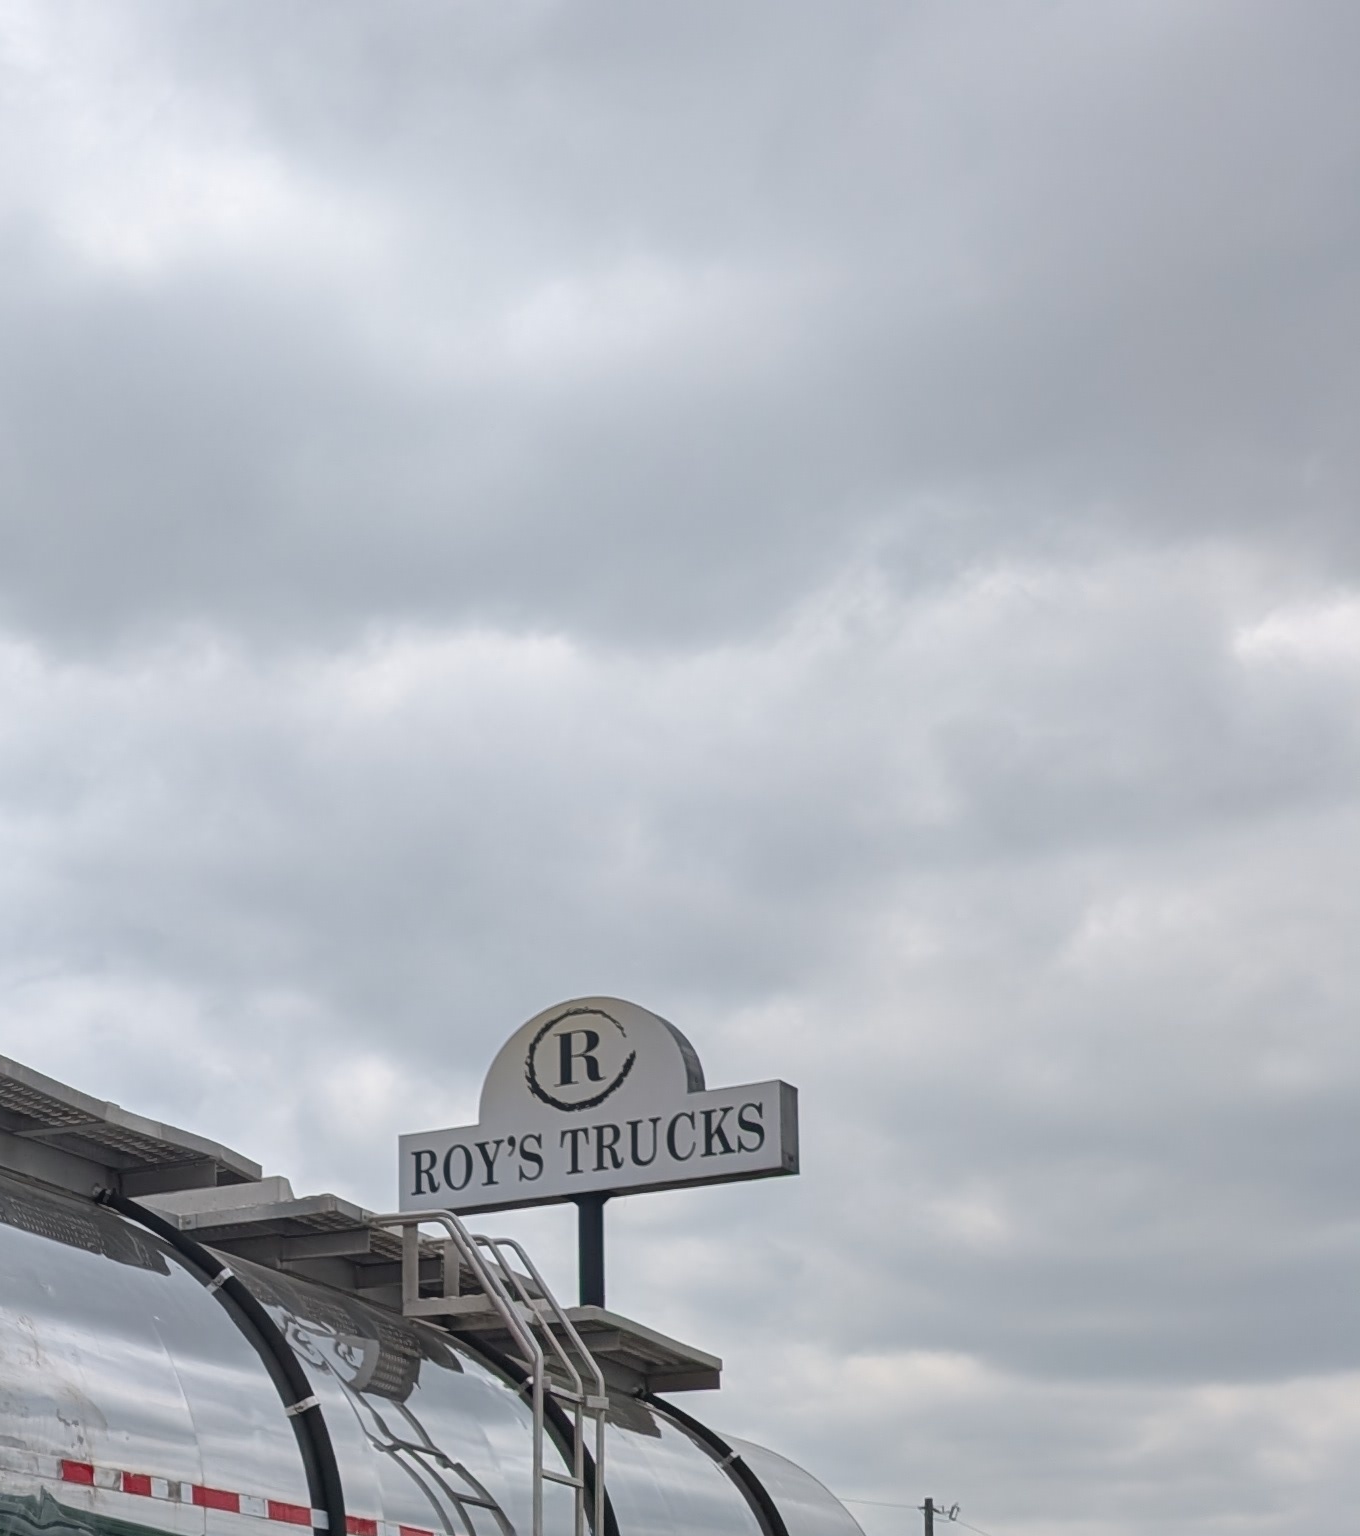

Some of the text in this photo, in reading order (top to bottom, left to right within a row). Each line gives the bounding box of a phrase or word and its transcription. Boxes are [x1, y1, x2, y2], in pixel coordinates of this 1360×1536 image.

[553, 1029, 606, 1087] R
[411, 1102, 766, 1196] ROY'S TRUCKS
